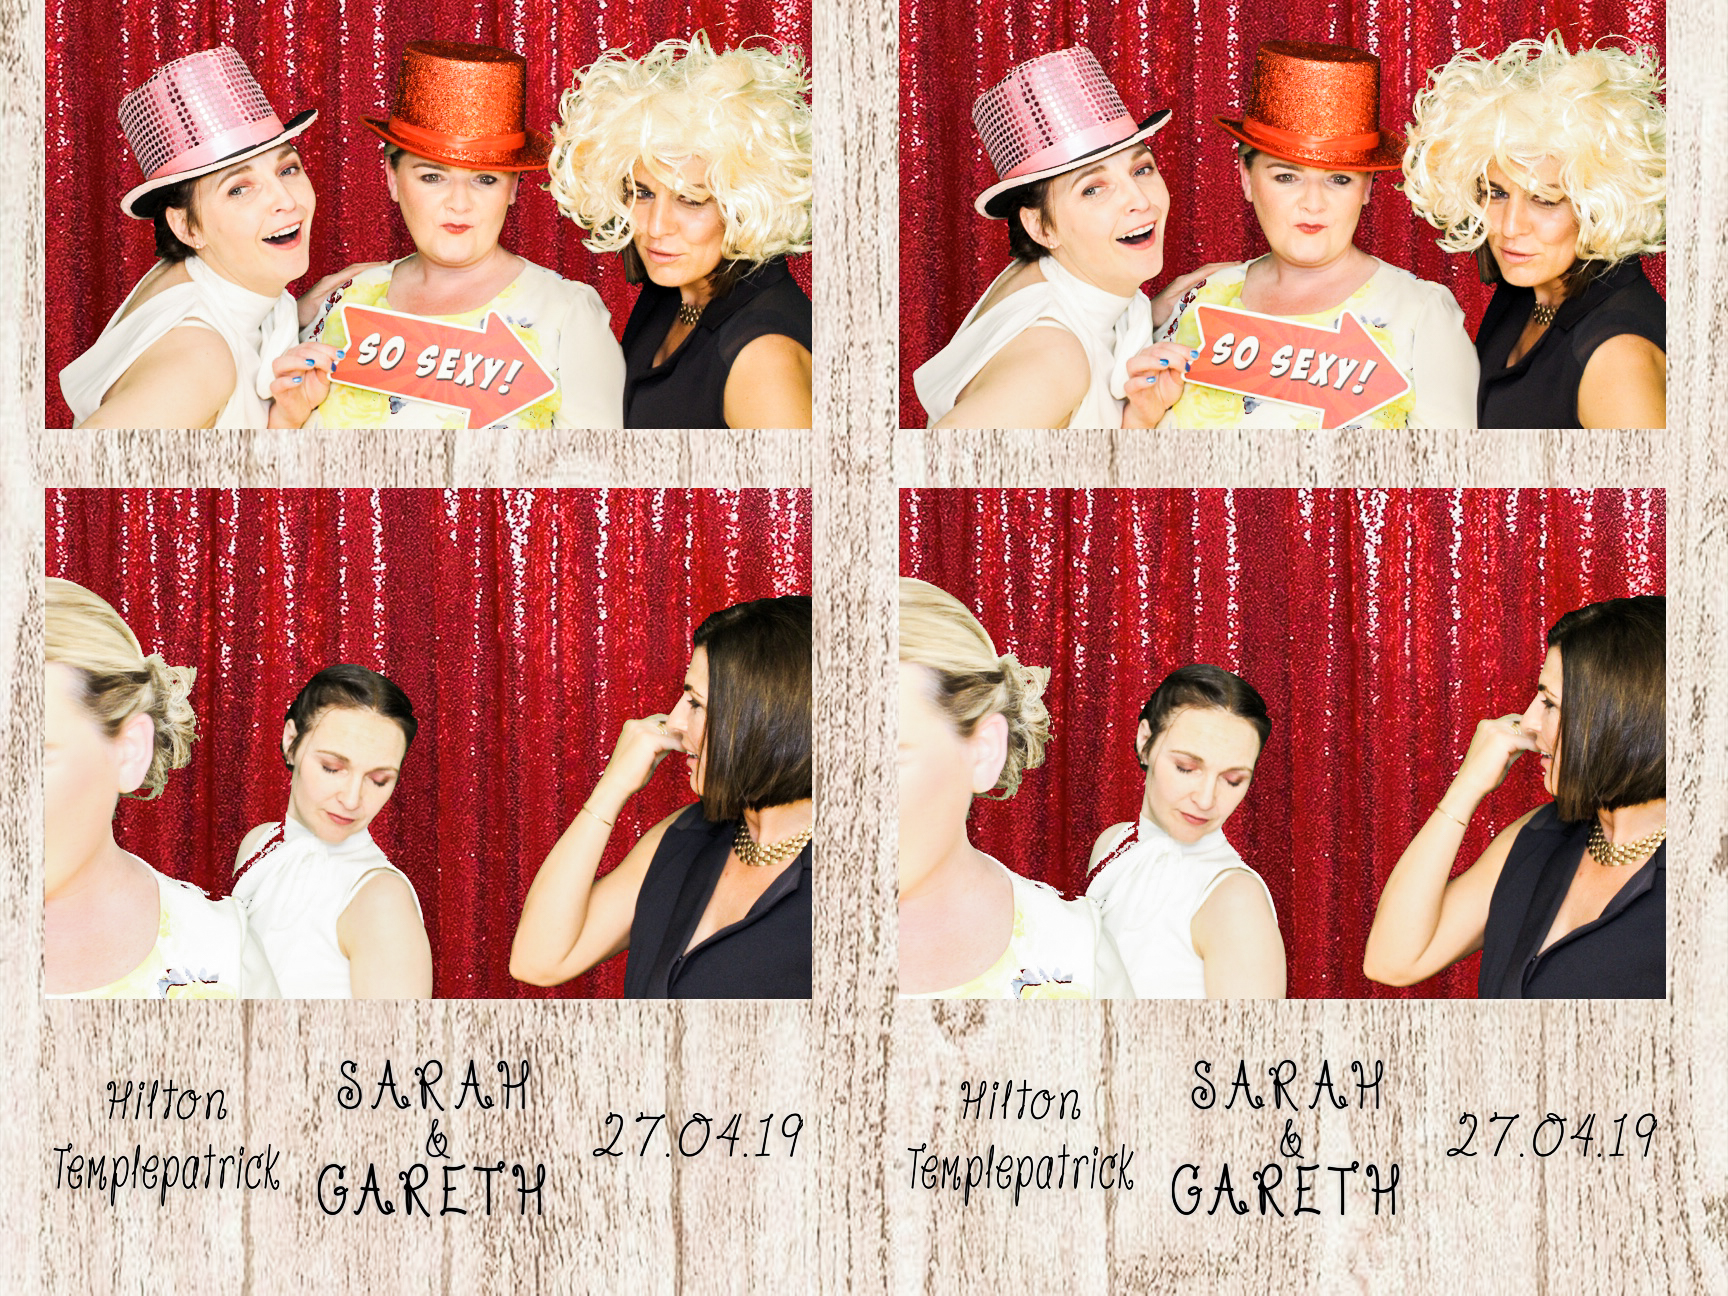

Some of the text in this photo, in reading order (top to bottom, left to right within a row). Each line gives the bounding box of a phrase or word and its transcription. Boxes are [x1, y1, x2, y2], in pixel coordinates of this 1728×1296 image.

[357, 332, 524, 395] SO SEXY!
[1211, 332, 1378, 395] SO SEXY!
